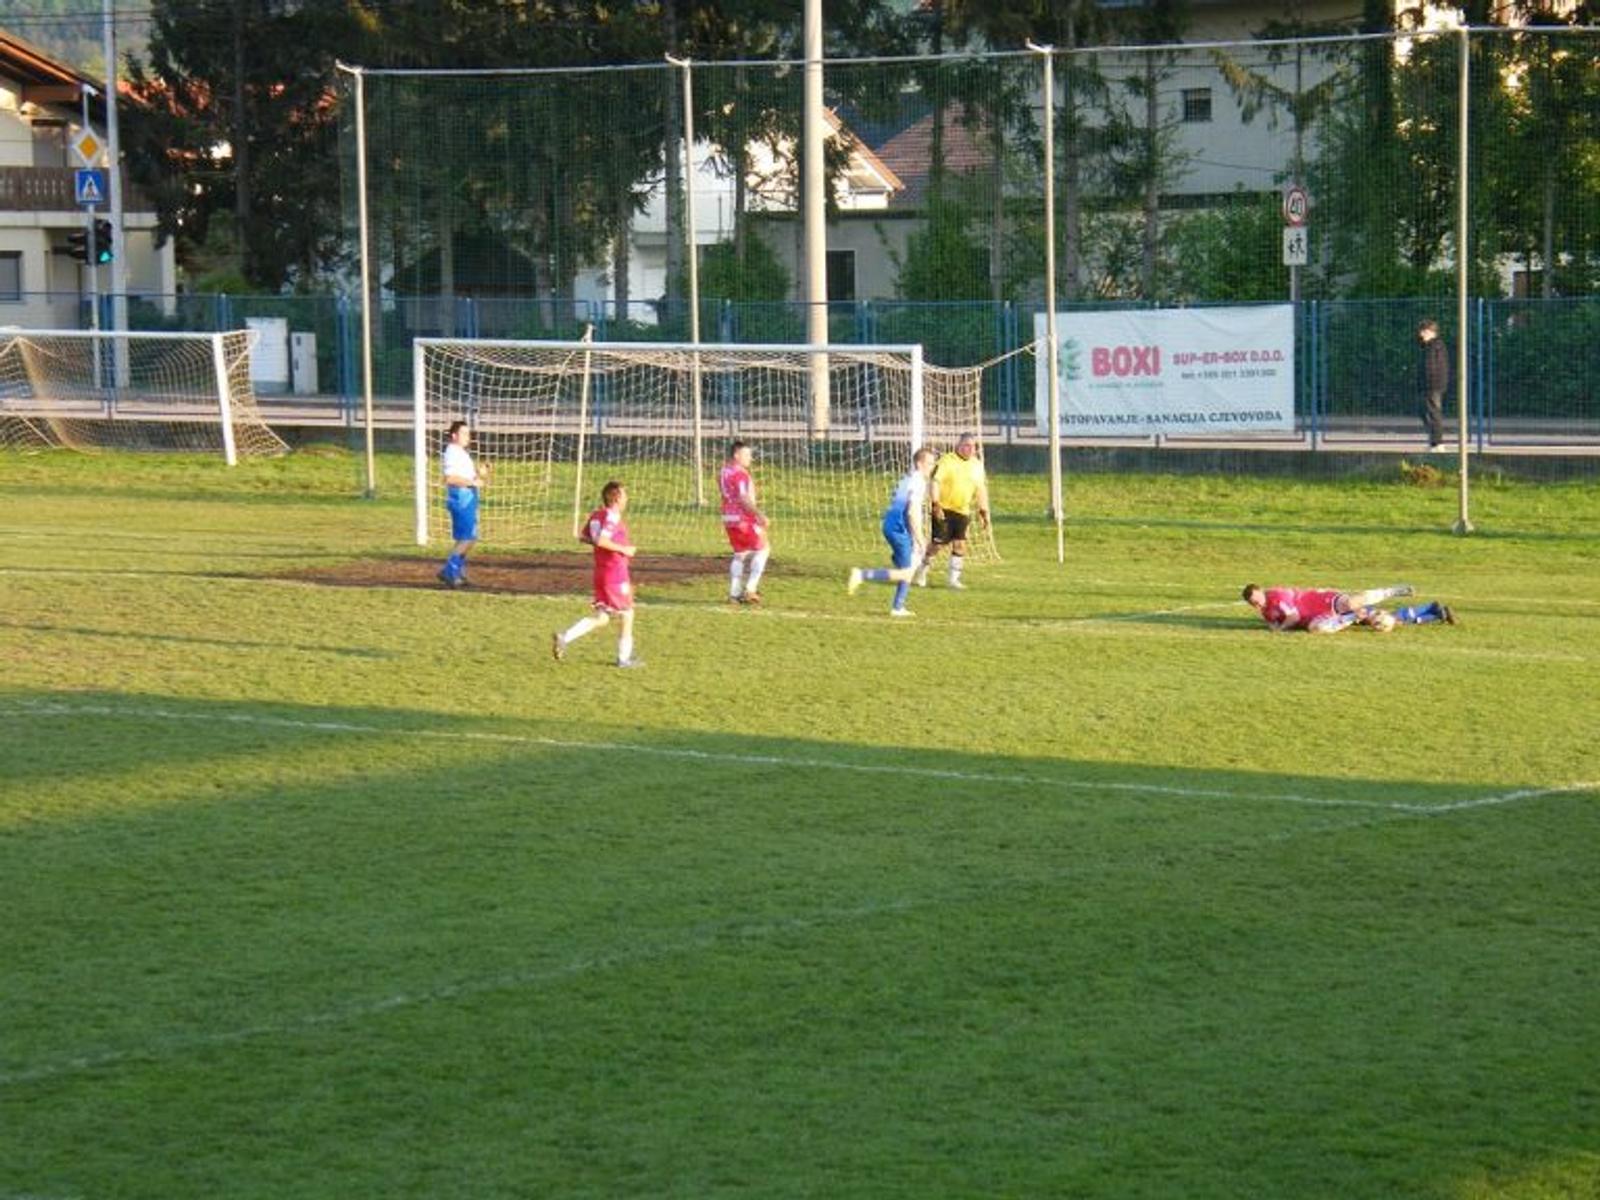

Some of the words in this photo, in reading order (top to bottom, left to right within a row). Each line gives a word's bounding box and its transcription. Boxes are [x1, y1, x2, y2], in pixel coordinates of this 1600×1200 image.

[1290, 197, 1303, 215] 40
[1091, 345, 1161, 377] BOXI
[1208, 410, 1282, 422] CJEVOVODA
